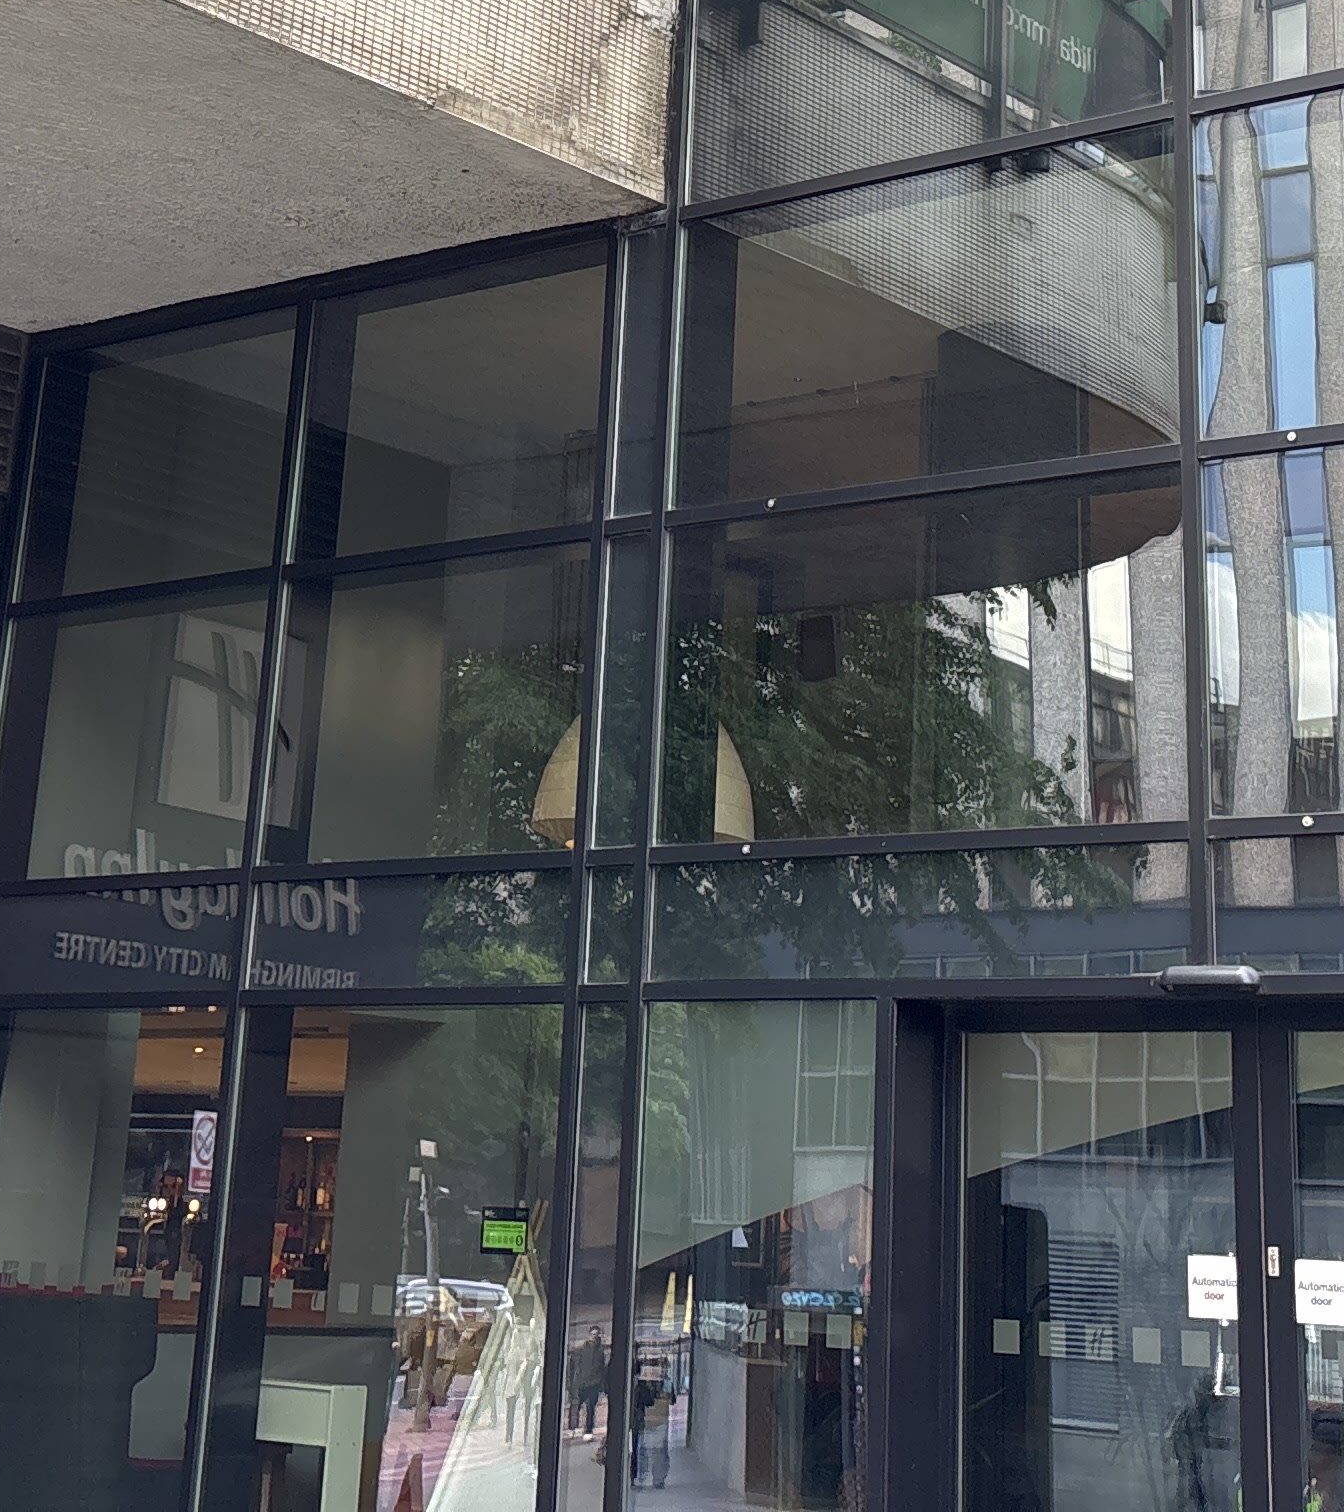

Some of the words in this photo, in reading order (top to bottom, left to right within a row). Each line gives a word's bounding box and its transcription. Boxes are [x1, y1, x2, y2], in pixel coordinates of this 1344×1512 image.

[1192, 1276, 1237, 1287] Automatic
[1298, 1281, 1344, 1293] Automatic
[1204, 1291, 1224, 1301] door
[1311, 1297, 1332, 1306] door
